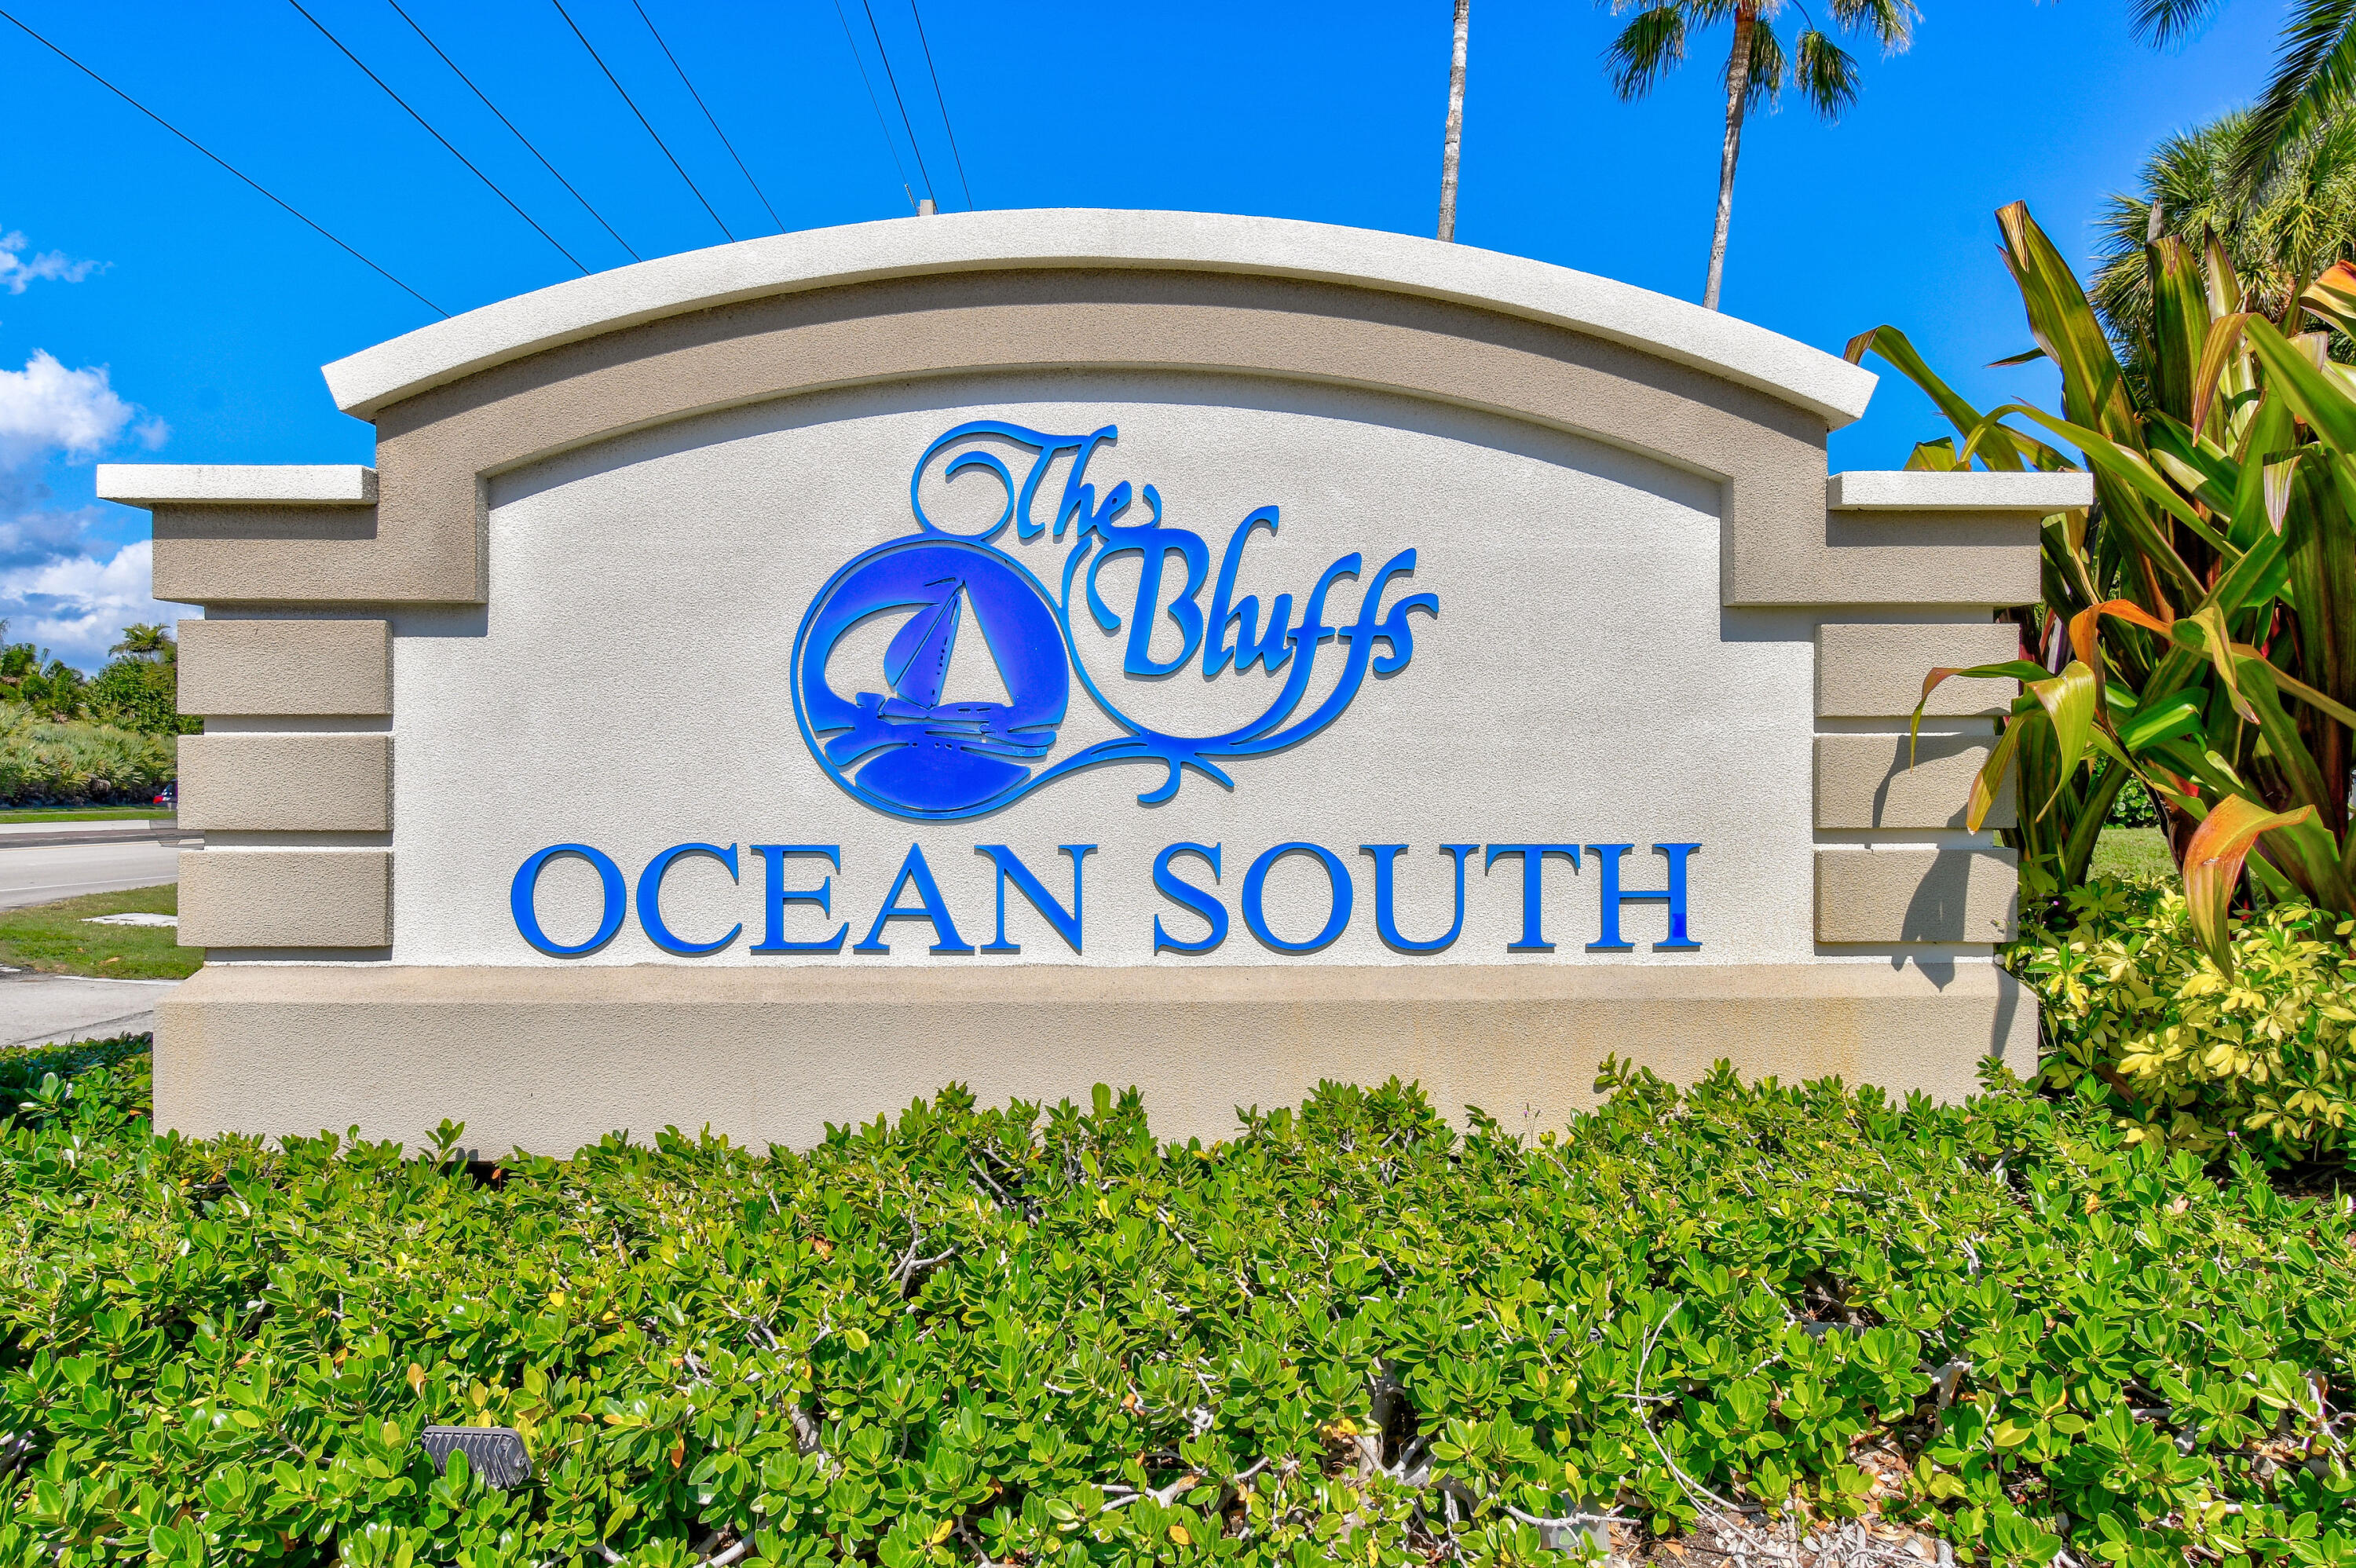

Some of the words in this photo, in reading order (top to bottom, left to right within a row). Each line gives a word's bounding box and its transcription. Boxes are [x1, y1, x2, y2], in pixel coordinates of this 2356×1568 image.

[912, 420, 1162, 542] The
[1063, 505, 1439, 755] Bluffs
[510, 842, 1097, 955] OCEAN
[1152, 842, 1703, 952] SOUTH
